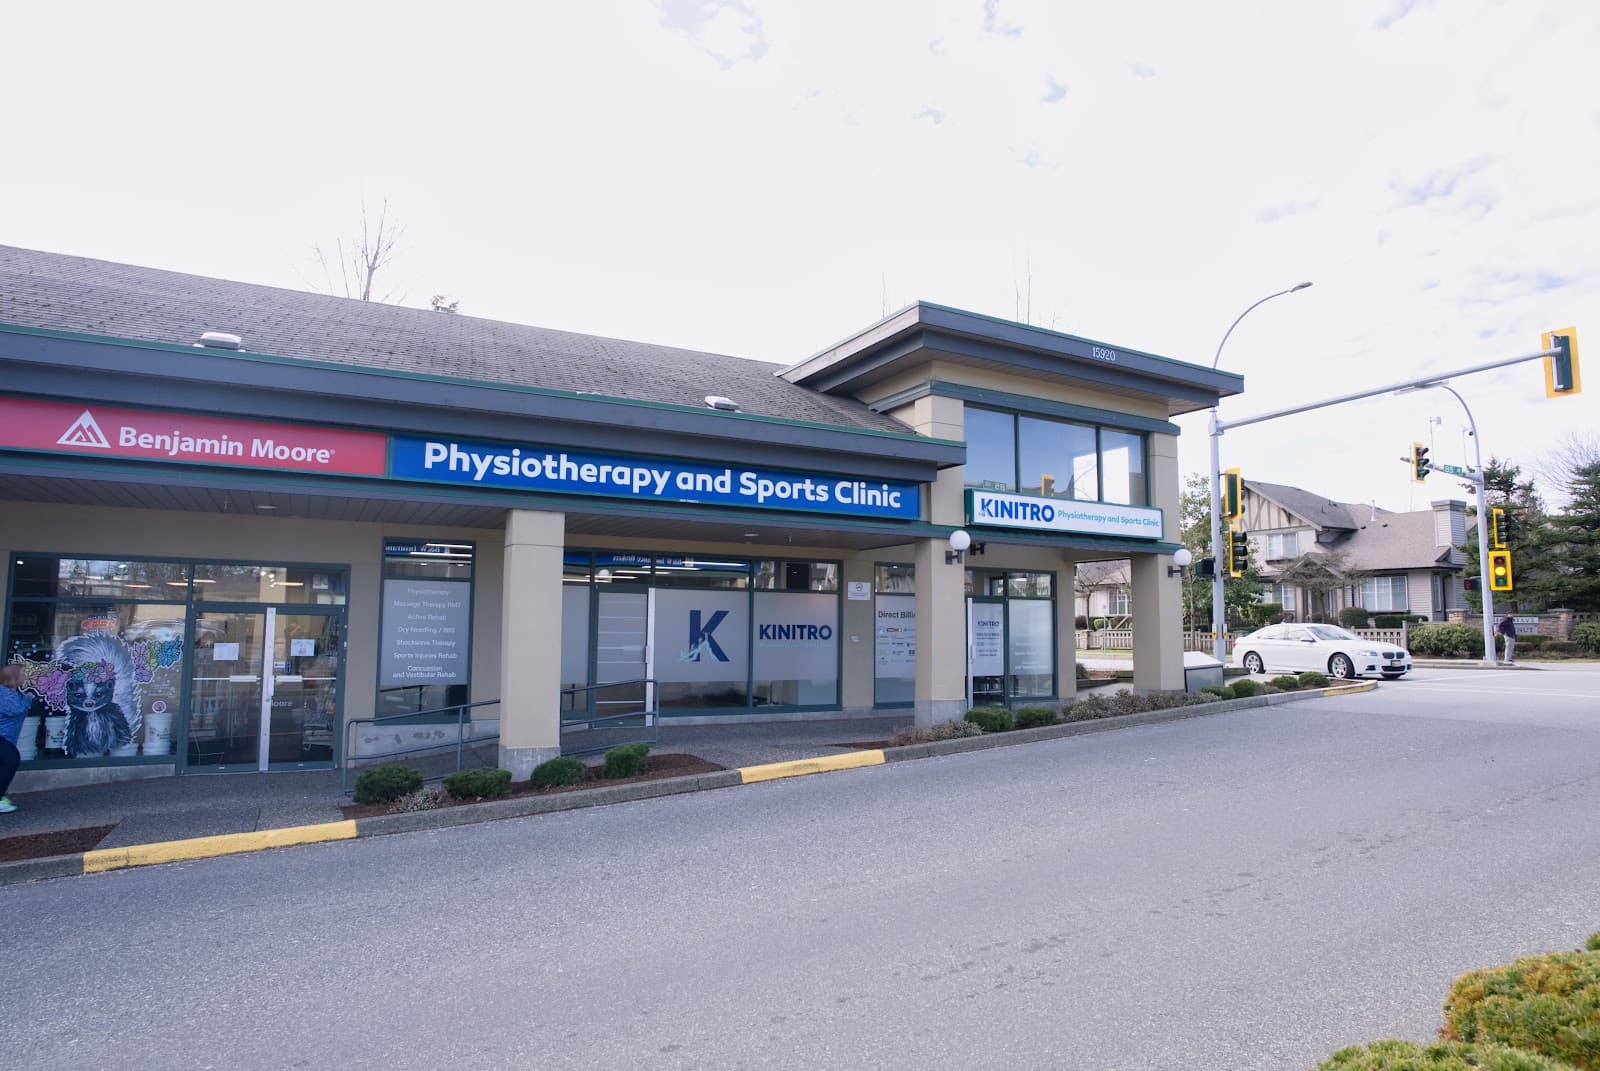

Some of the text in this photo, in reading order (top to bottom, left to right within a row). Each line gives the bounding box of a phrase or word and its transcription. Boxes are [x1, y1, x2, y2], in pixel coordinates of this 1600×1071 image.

[1092, 346, 1116, 362] 15920
[119, 426, 331, 464] Benjamin Moore
[424, 442, 901, 509] Physiotherapy and Sports Clinic
[980, 497, 1159, 527] KINITRO Physiotherapy and Sports Clinic
[878, 610, 899, 618] Direct
[397, 626, 409, 634] Dry
[410, 626, 438, 635] Needling
[758, 623, 833, 641] KINITRO
[432, 639, 456, 648] Therapy
[393, 652, 414, 660] Sports
[438, 652, 458, 660] Rehab
